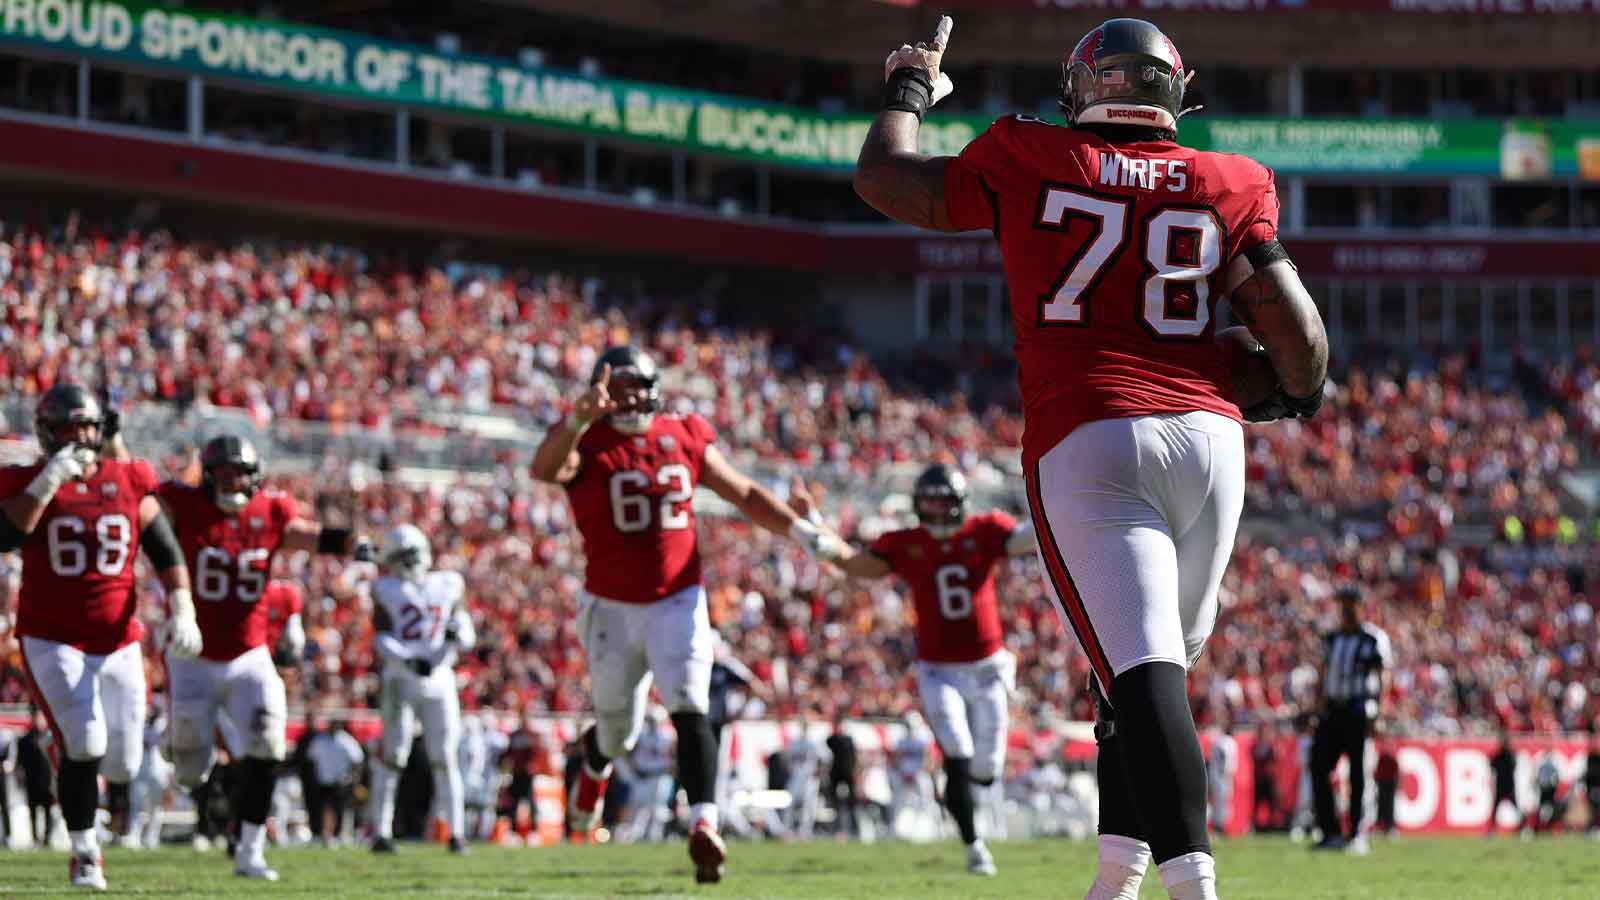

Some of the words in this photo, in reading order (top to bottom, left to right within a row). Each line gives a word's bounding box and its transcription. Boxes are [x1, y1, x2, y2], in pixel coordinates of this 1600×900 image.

[142, 12, 346, 82] SPONSOR
[354, 46, 410, 93] OF
[415, 57, 492, 110] THE
[498, 71, 615, 130] TAMPA
[625, 91, 692, 140] BAY
[1099, 151, 1188, 193] WIRFS
[1040, 187, 1223, 338] 78
[608, 462, 694, 534] 62
[46, 512, 133, 578] 68
[194, 546, 271, 602] 65
[398, 606, 446, 640] 27
[934, 563, 973, 622] 6
